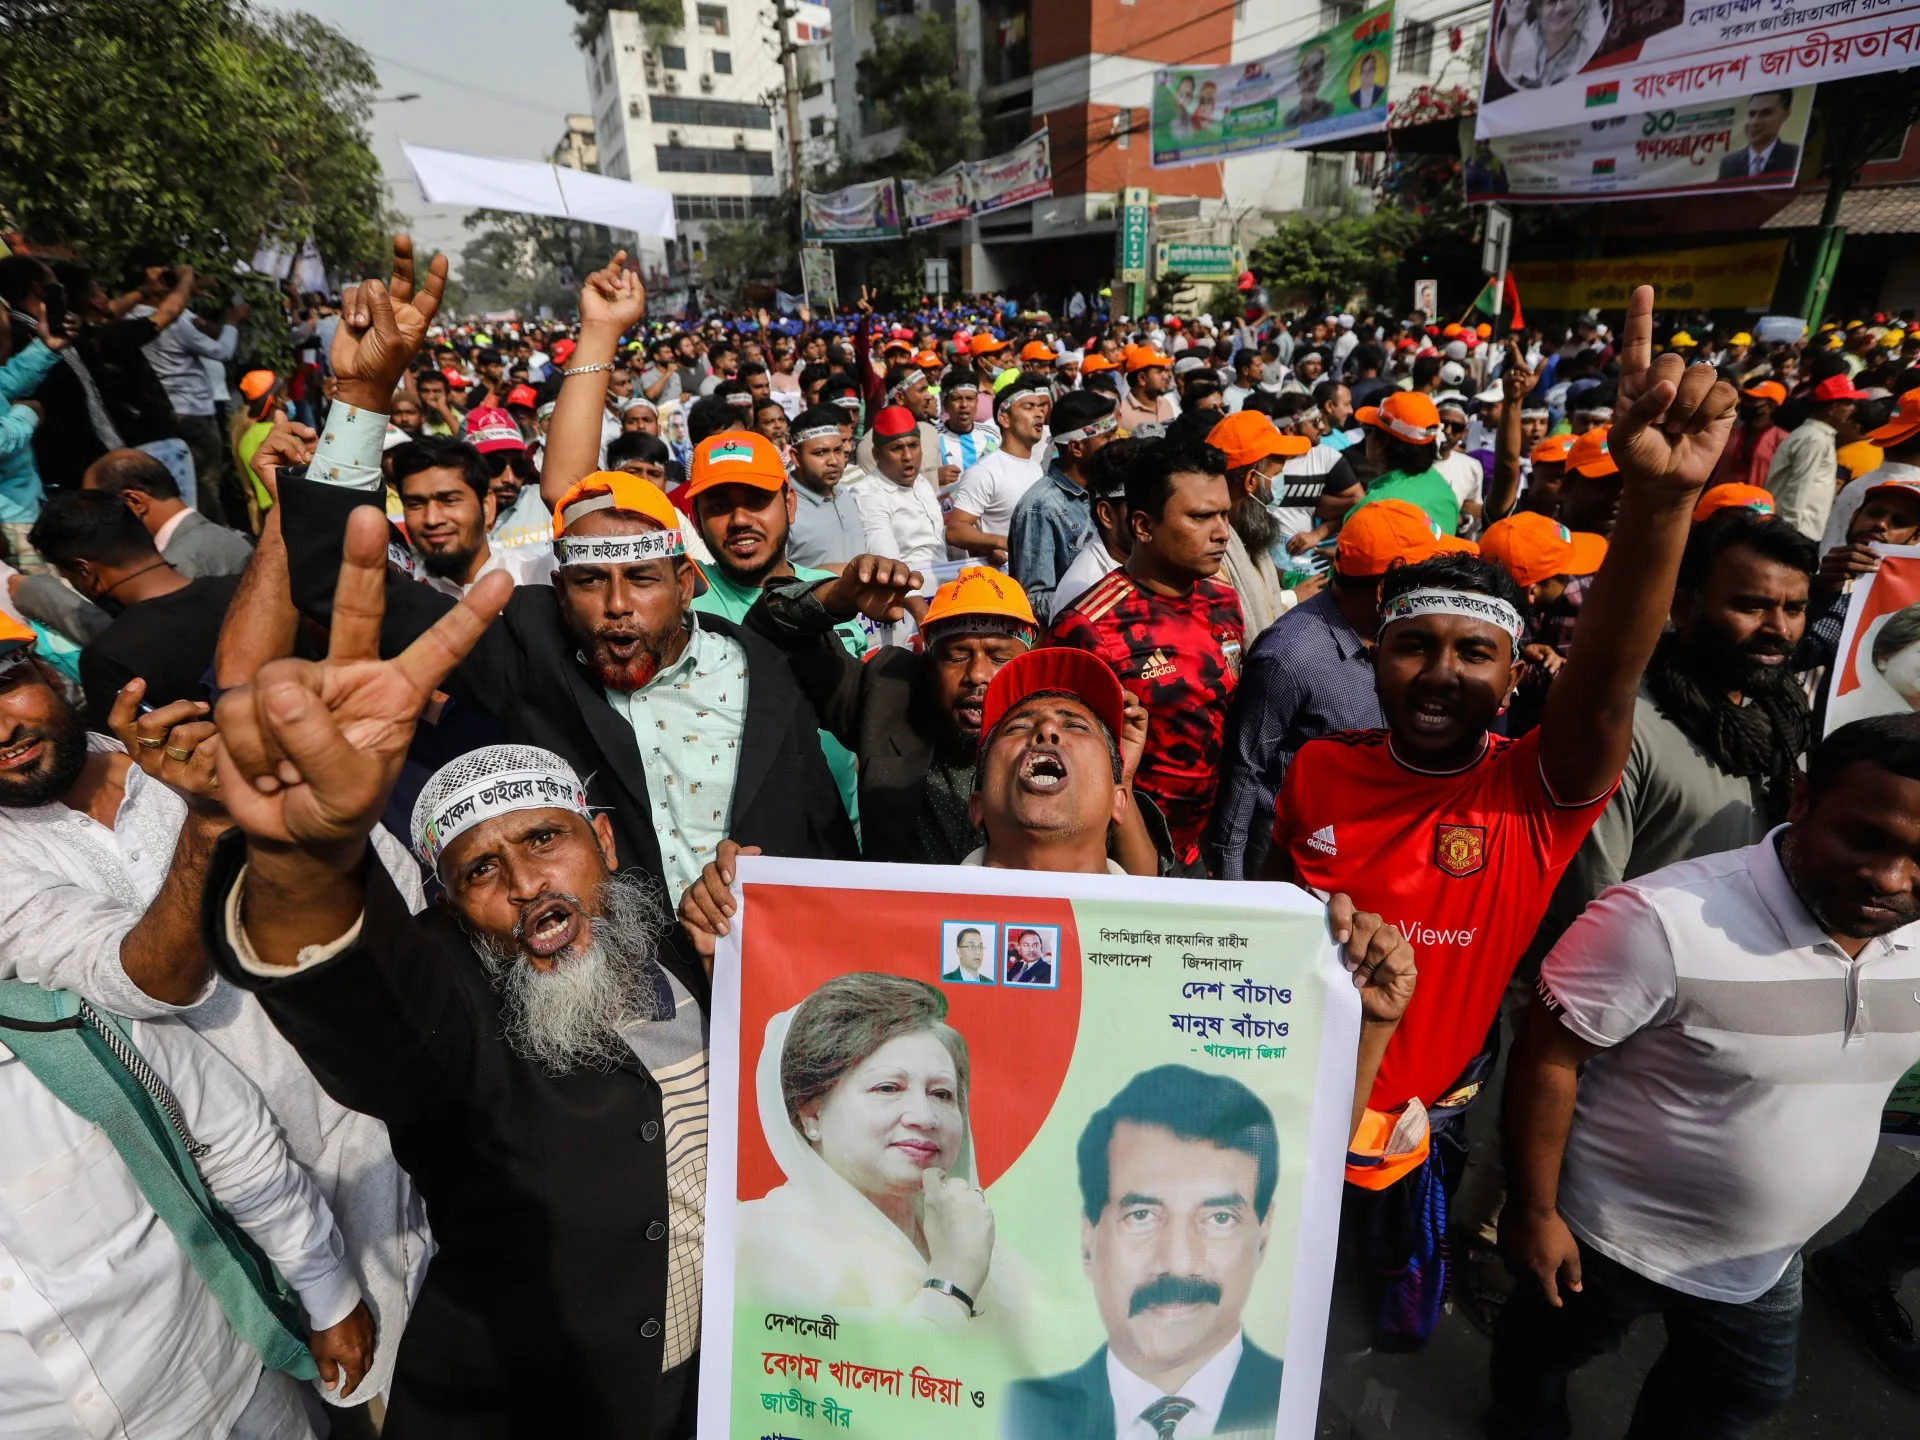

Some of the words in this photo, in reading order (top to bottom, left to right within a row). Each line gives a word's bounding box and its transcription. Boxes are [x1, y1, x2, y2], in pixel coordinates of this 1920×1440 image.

[1632, 53, 1752, 101] বাংলাদেশ
[1642, 110, 1676, 136] ১০
[1129, 206, 1143, 268] QUALITY
[1125, 270, 1144, 281] CNG
[592, 540, 630, 559] ভাইয়ের
[632, 537, 652, 559] মুক্তি
[1410, 595, 1447, 609] খোকন
[1447, 594, 1490, 615] ভাইয়ের
[1490, 604, 1506, 623] মুক্তি
[1141, 665, 1177, 680] adidas
[435, 794, 476, 837] খোকন
[478, 779, 534, 806] ভাইয়ের
[537, 776, 559, 802] মুক্তি
[560, 785, 573, 802] চাই
[1307, 837, 1338, 856] adidas
[1444, 830, 1478, 847] MANCHESTER
[1447, 858, 1471, 867] UNITED
[1100, 928, 1161, 945] বিসমিল্লাহির
[1165, 932, 1213, 948] রাহমানির
[1217, 933, 1249, 949] রাহীম
[1088, 952, 1152, 968] বাংলাদেশ
[1182, 953, 1244, 972] জিন্দাবাদ
[1182, 981, 1225, 1001] দেশ
[1230, 978, 1292, 1005] বাঁচাও
[1169, 1013, 1225, 1039] মানুষ
[1230, 1013, 1289, 1039] বাঁচাও
[1203, 1043, 1252, 1060] খালেদা
[1256, 1044, 1287, 1060] জিয়া
[764, 1313, 839, 1341] দেশনেত্রী
[761, 1351, 821, 1383] বেগম
[828, 1358, 903, 1398] খালেদা
[911, 1365, 964, 1407] জিয়া
[970, 1390, 985, 1409] ও
[760, 1388, 817, 1420] জাতীয়
[820, 1397, 853, 1430] বীর
